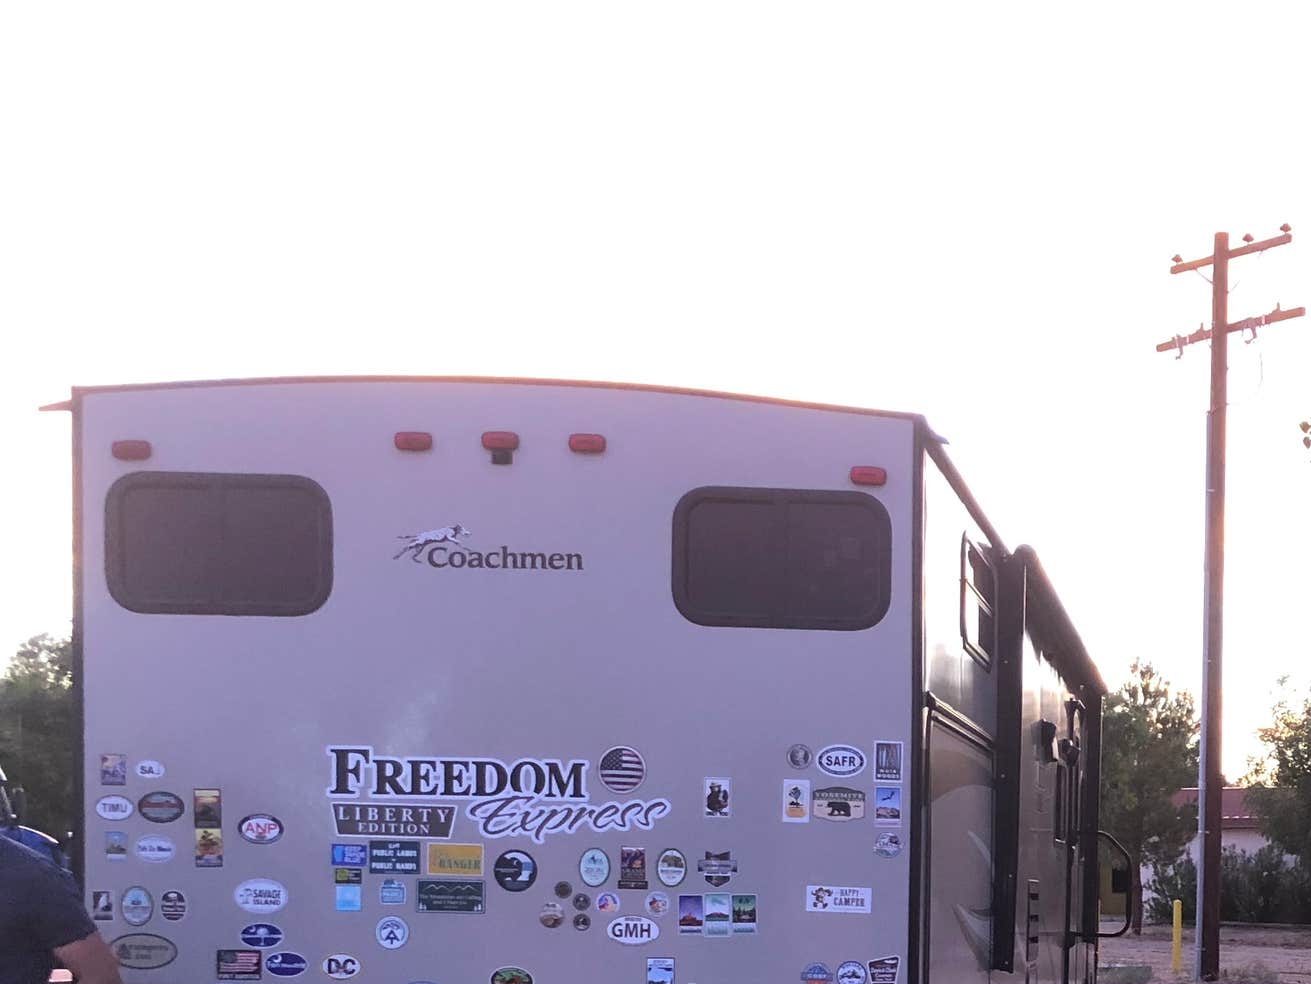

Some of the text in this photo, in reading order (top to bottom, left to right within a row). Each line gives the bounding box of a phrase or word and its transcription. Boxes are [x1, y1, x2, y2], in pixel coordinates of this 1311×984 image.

[427, 545, 584, 570] Coachmen
[825, 755, 856, 767] SAFR
[329, 748, 586, 798] FREEDOM
[338, 805, 450, 823] LIBERTY
[469, 795, 668, 841] Express
[358, 822, 431, 835] EDITION
[833, 897, 865, 907] CAMPER
[612, 922, 651, 938] GMH
